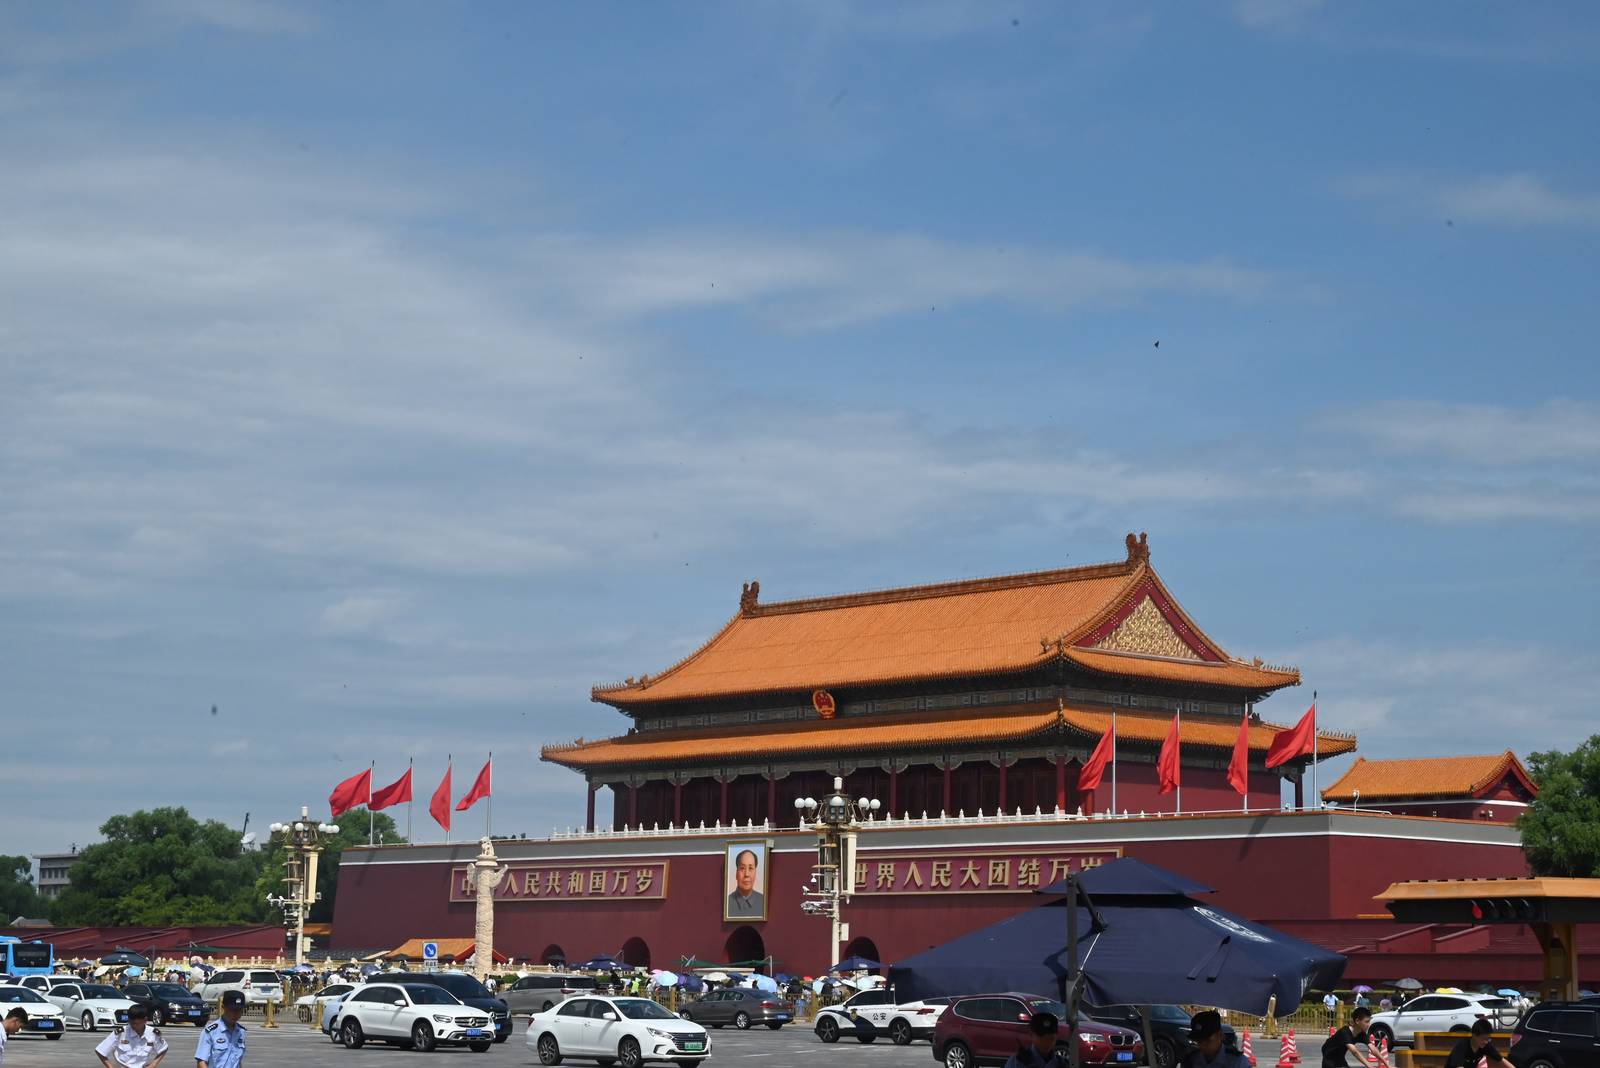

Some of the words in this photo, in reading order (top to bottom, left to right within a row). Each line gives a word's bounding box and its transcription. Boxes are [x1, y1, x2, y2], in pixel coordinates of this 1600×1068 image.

[461, 868, 654, 896] 中人民共和国万岁
[872, 1012, 887, 1021] 公安
